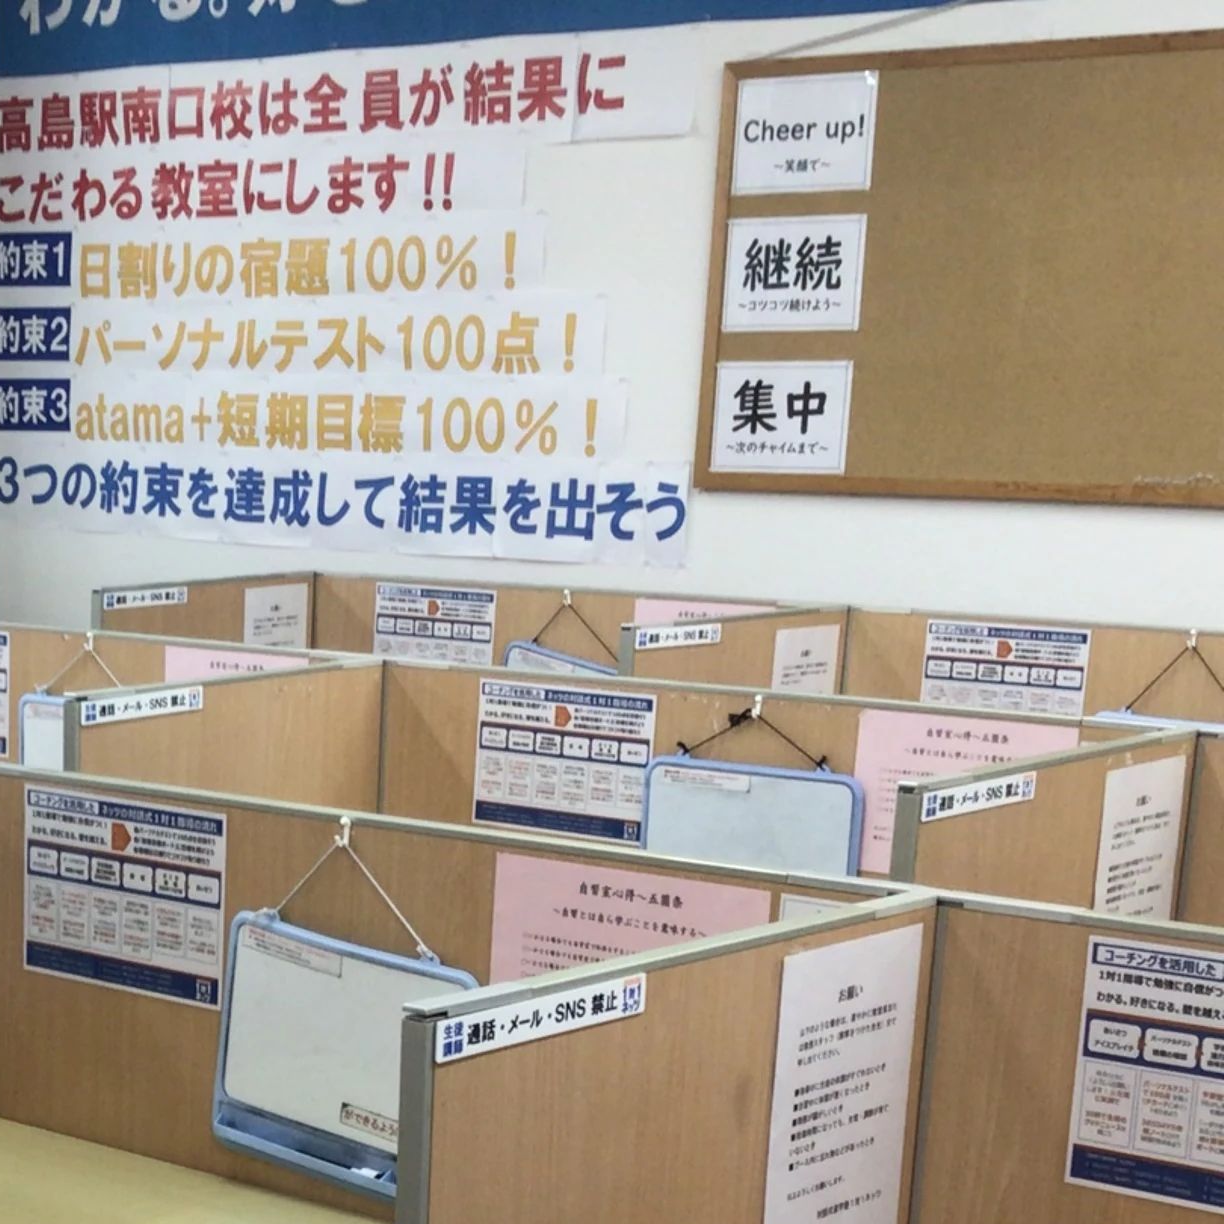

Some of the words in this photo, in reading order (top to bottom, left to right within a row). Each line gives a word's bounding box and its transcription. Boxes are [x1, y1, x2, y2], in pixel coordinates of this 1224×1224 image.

[744, 119, 817, 143] Cheer
[826, 114, 865, 144] up!
[743, 235, 843, 292] 継続
[77, 313, 577, 374] パーソナルテスト100点！
[732, 380, 827, 436] 集中
[1104, 949, 1217, 977] コーチングを活用した
[467, 998, 586, 1046] 通話・メール・SNS
[591, 990, 617, 1015] 禁止
